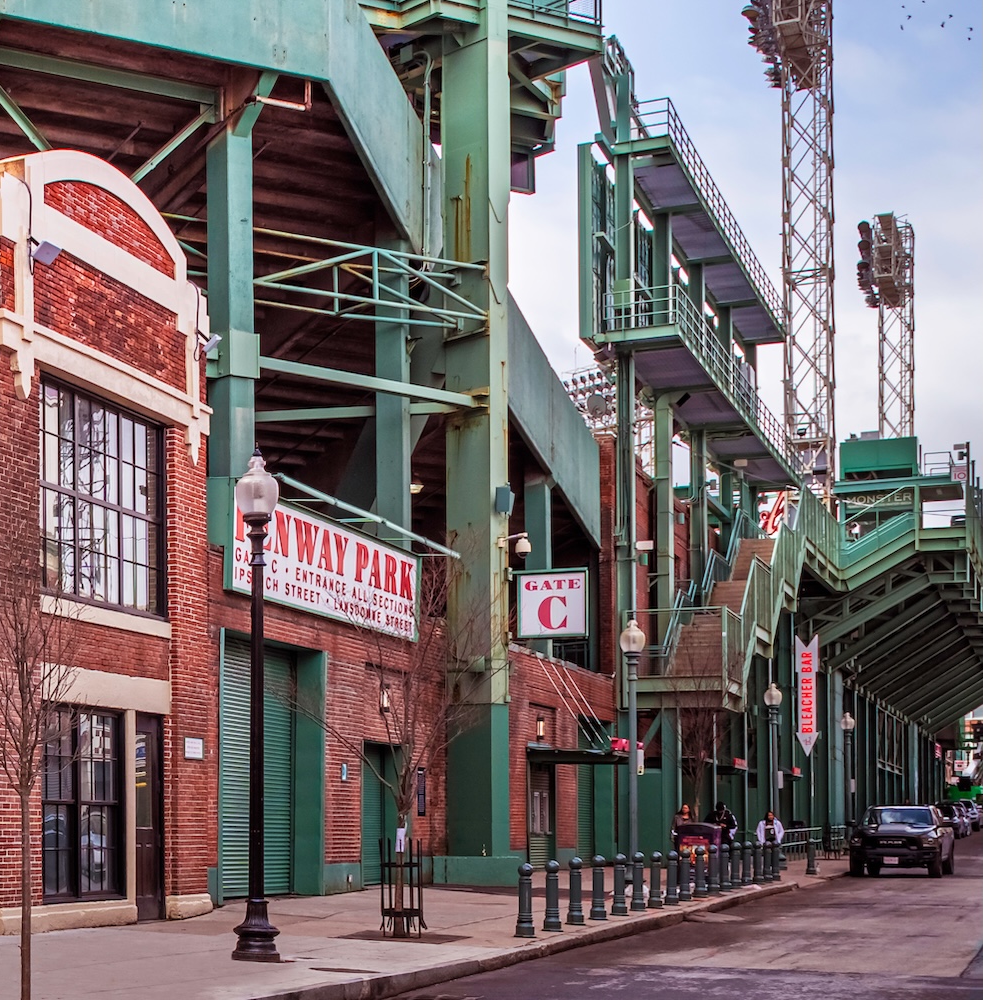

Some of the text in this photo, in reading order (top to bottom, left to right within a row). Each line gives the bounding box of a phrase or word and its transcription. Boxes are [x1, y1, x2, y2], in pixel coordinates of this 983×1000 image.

[235, 503, 414, 601] FNWAY PARK
[234, 566, 279, 593] IPSCH
[284, 582, 321, 605] STREET
[385, 613, 413, 636] STREET
[295, 567, 346, 596] ENTRANCE
[351, 586, 368, 603] ALL
[372, 593, 414, 618] SECTIONS
[524, 578, 581, 591] GATE
[537, 595, 568, 630] C
[801, 652, 813, 673] BAR
[801, 678, 813, 734] BLEACHER
